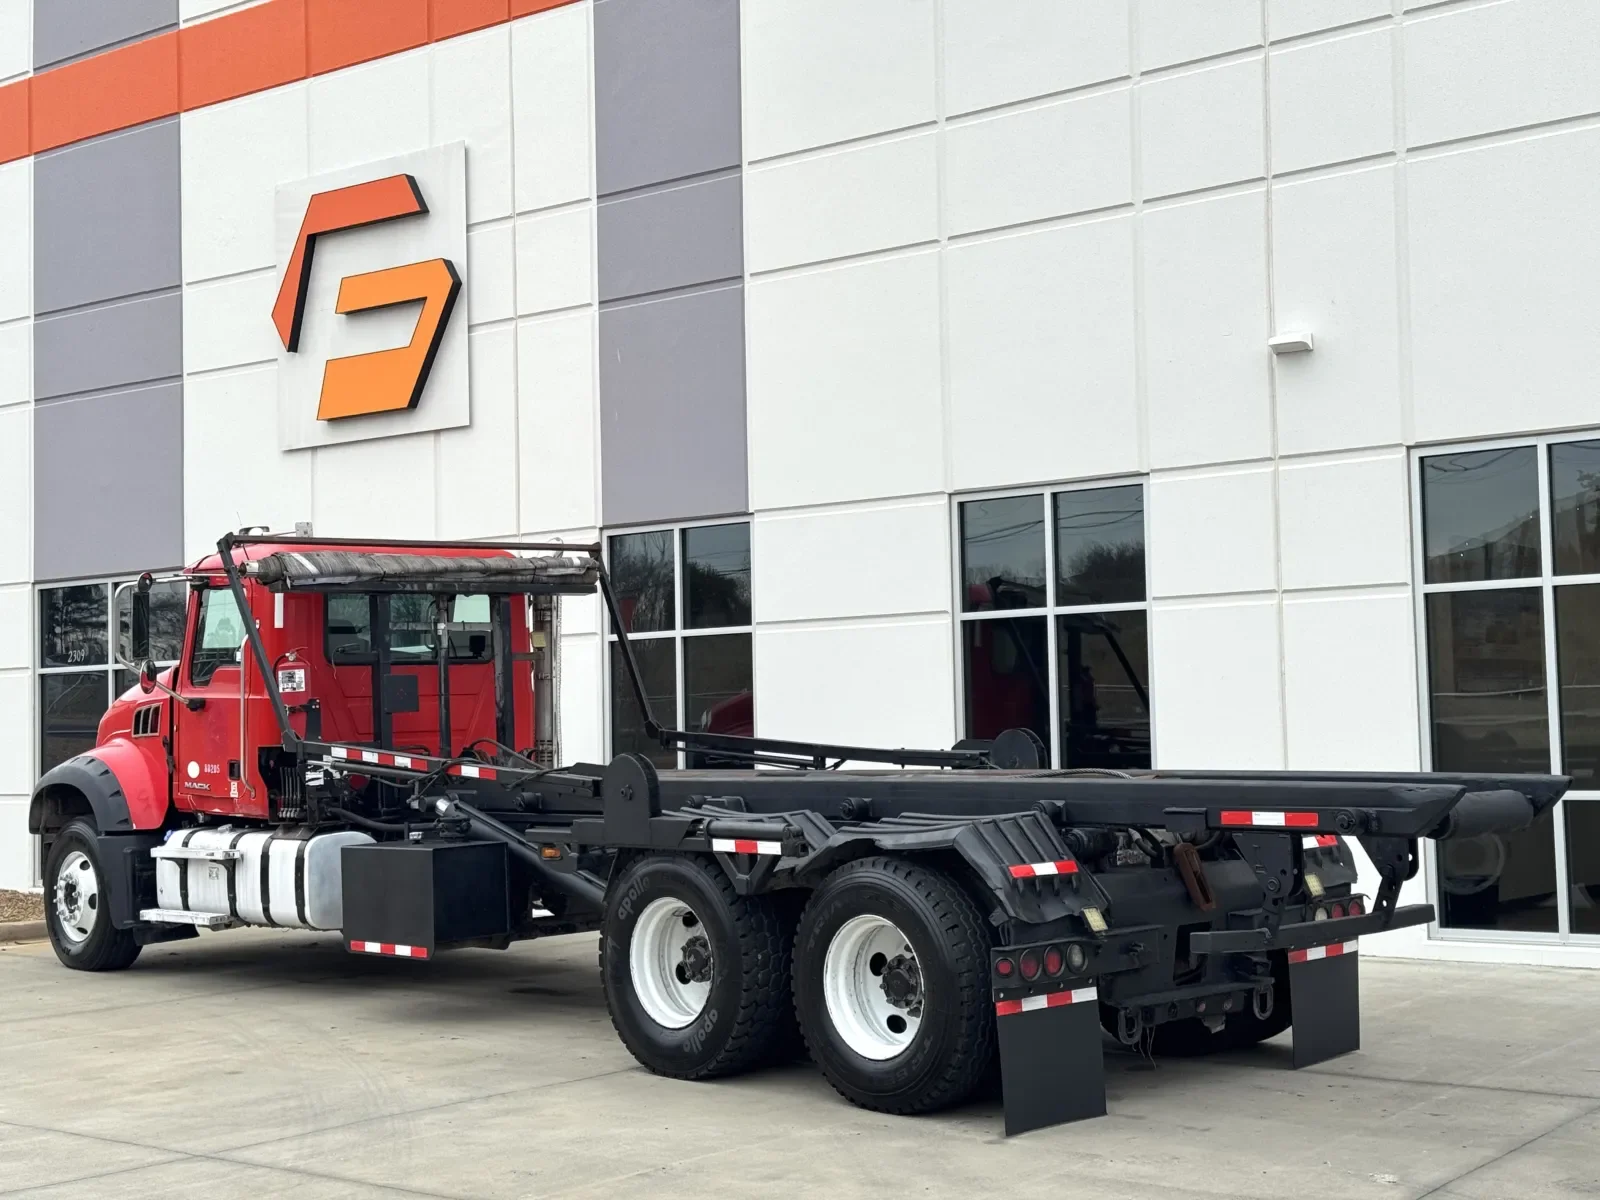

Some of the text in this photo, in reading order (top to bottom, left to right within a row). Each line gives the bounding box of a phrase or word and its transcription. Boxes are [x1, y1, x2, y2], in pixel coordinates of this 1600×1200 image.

[68, 649, 85, 663] 2309
[184, 781, 211, 791] MACK
[618, 876, 650, 920] apollo
[683, 1009, 718, 1055] apollo
